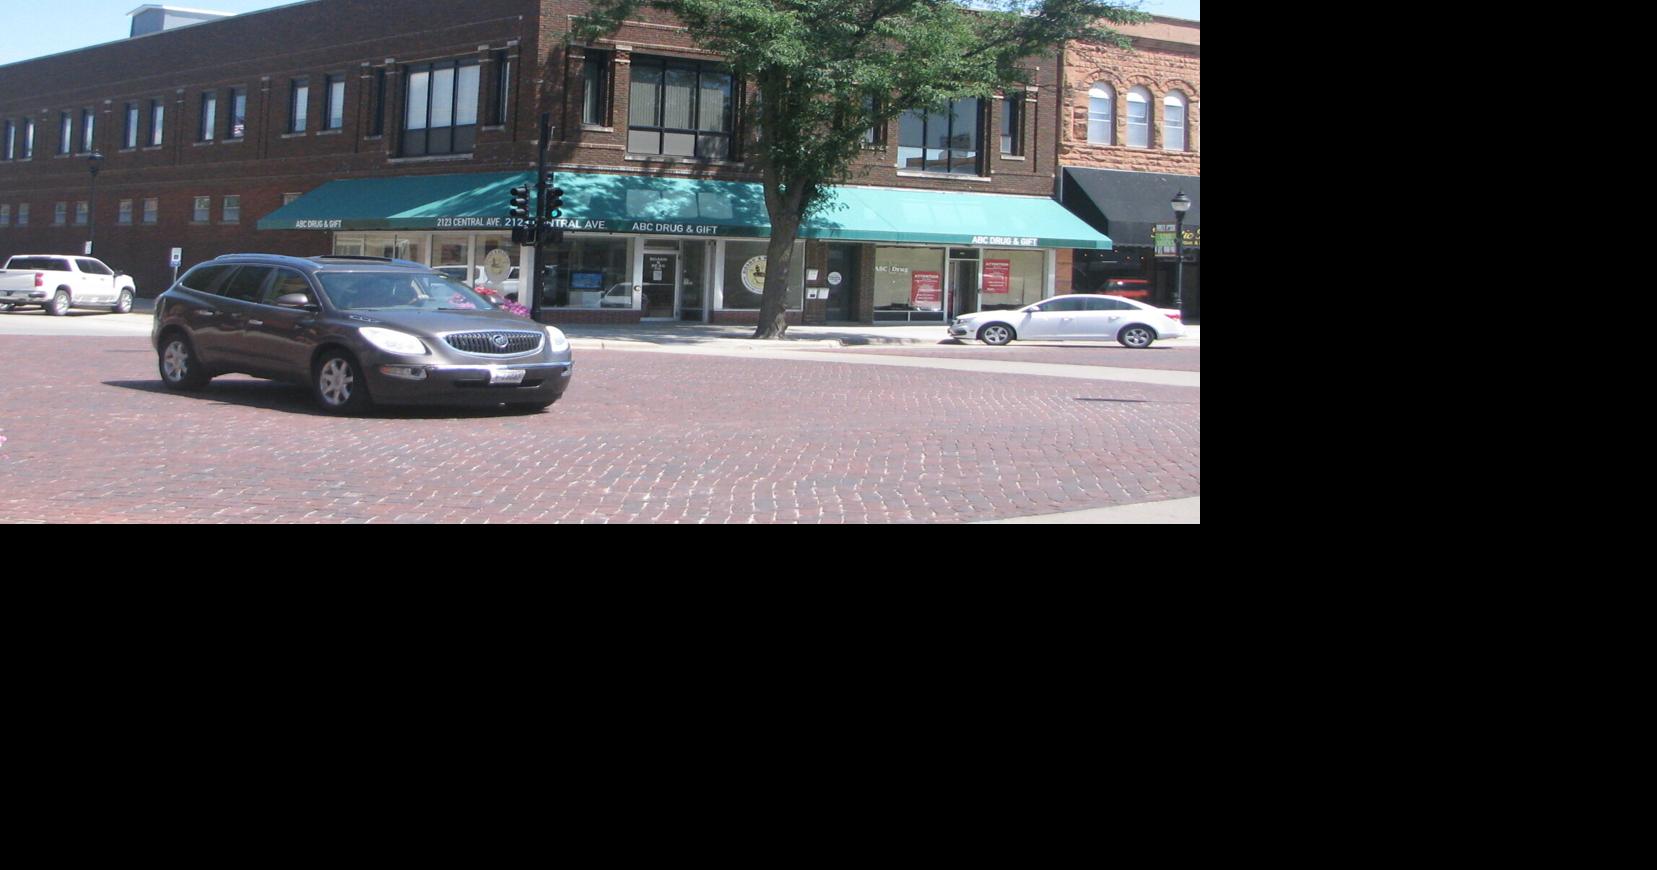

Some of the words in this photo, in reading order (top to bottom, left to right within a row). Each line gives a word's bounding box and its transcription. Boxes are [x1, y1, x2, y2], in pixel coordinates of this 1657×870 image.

[296, 219, 307, 228] ABC
[308, 219, 323, 228] DRUG
[324, 219, 329, 228] &
[330, 219, 342, 228] GIFT
[437, 217, 451, 227] 2123
[453, 217, 484, 227] CENTRAL
[505, 217, 530, 229] 212
[632, 222, 653, 232] ABC
[655, 223, 684, 233] DRUG
[686, 224, 693, 233] &
[696, 225, 718, 235] GIFT
[972, 236, 988, 244] ABC
[989, 236, 1011, 245] DRUG
[1013, 237, 1020, 246] &
[1020, 238, 1038, 247] GIFT
